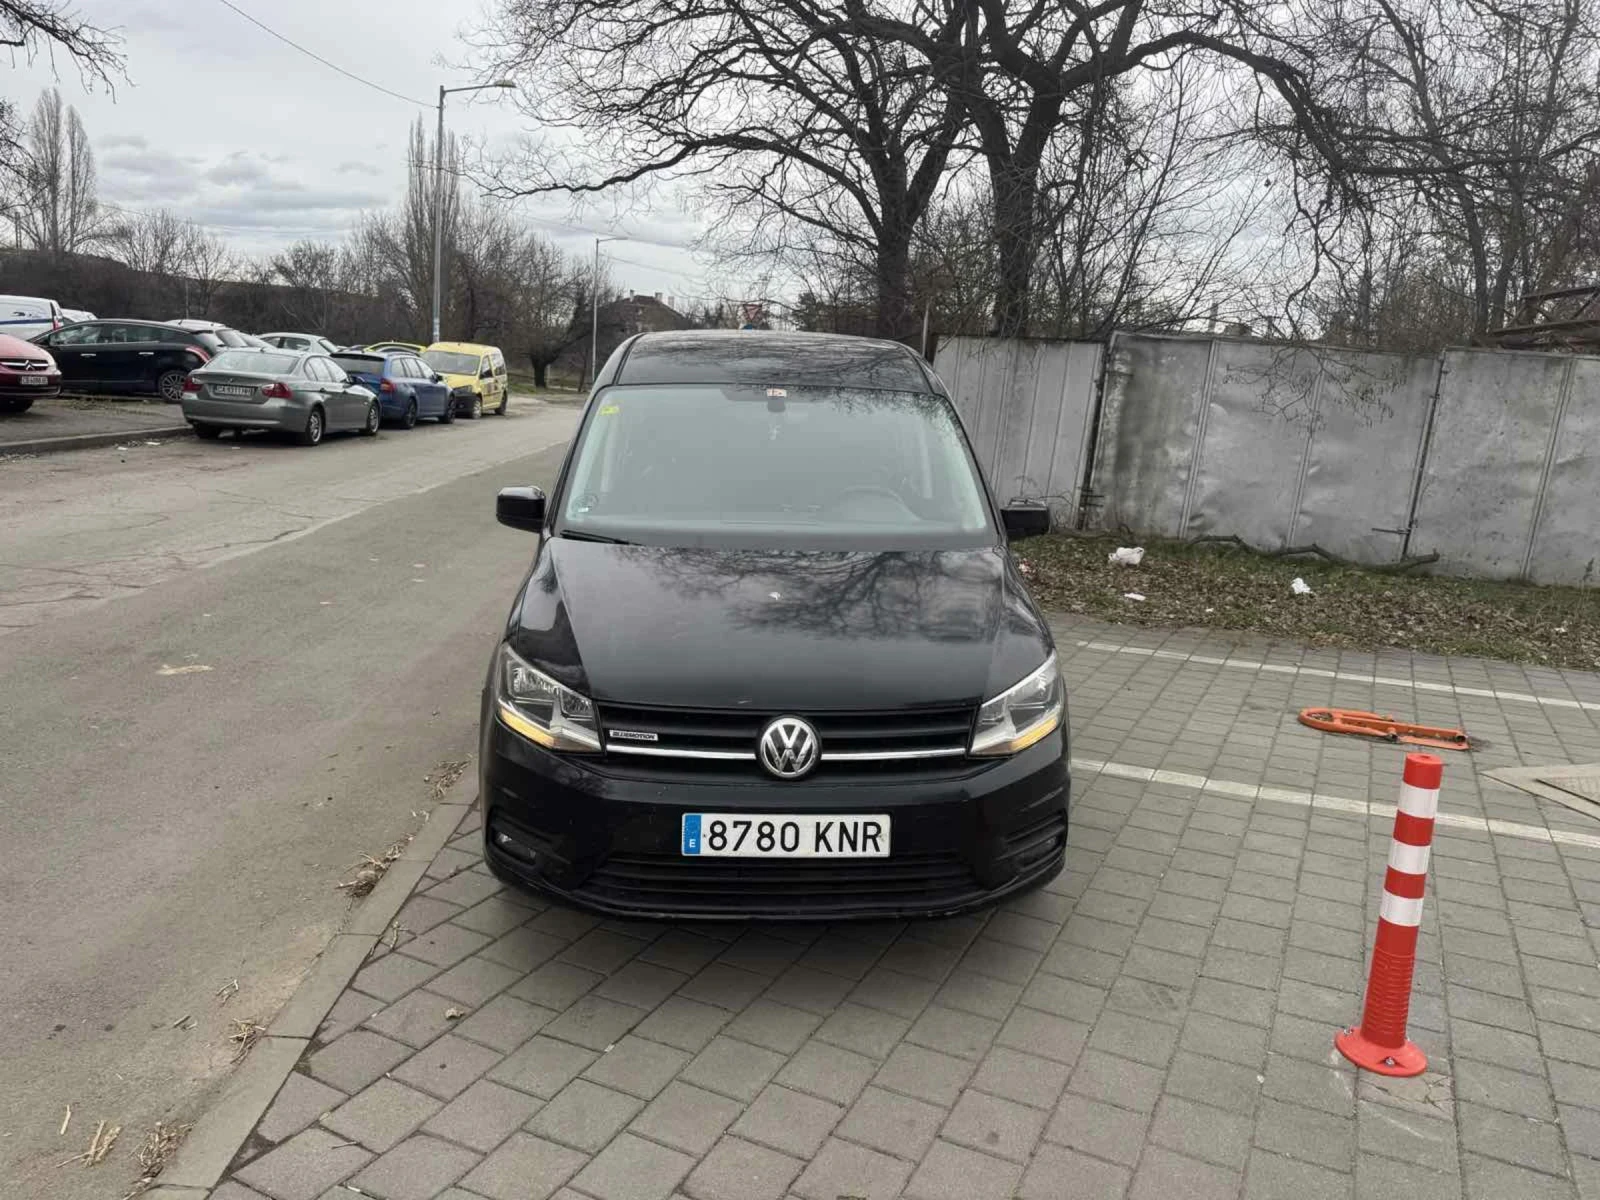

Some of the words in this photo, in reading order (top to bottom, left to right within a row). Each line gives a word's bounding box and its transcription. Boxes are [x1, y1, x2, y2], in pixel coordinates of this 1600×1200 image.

[688, 838, 697, 849] E
[707, 820, 800, 853] 8780
[814, 821, 882, 853] KNR
